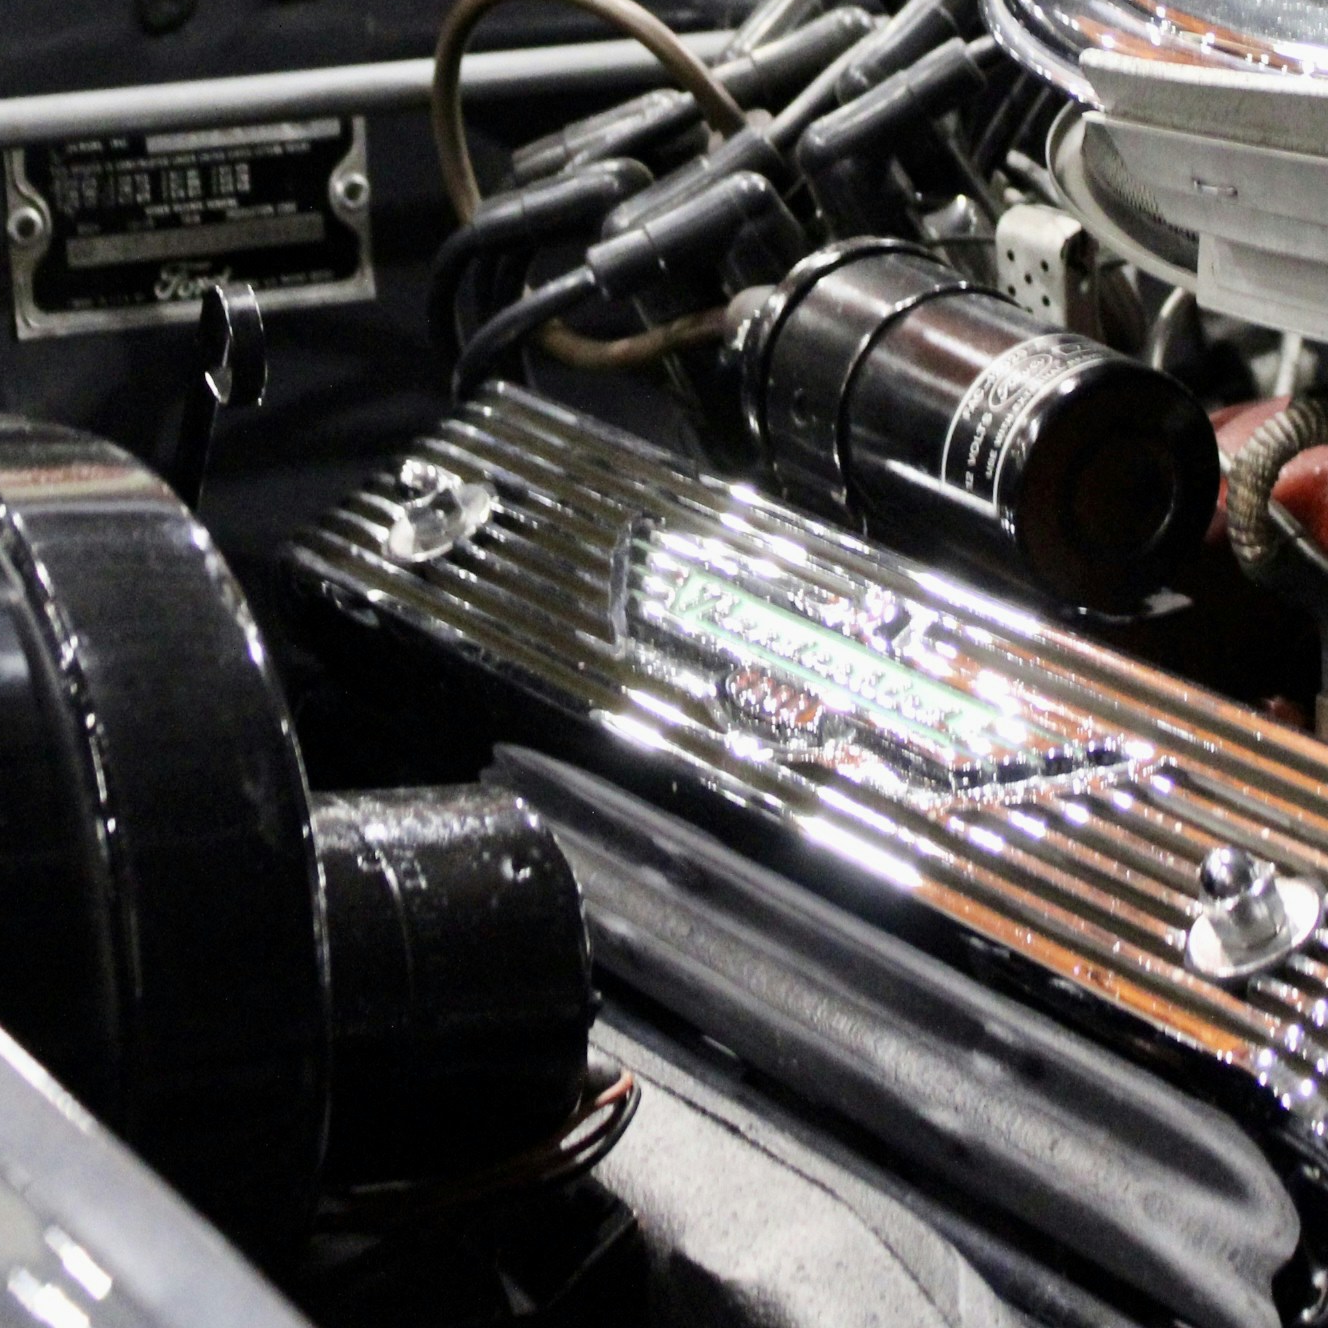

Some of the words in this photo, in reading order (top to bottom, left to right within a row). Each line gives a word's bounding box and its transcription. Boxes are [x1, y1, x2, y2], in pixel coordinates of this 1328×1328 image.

[967, 412, 993, 466] VOLTS
[985, 449, 998, 480] USE
[994, 413, 1014, 448] WITH
[1012, 365, 1066, 413] EXTNAL
[965, 470, 974, 490] 12
